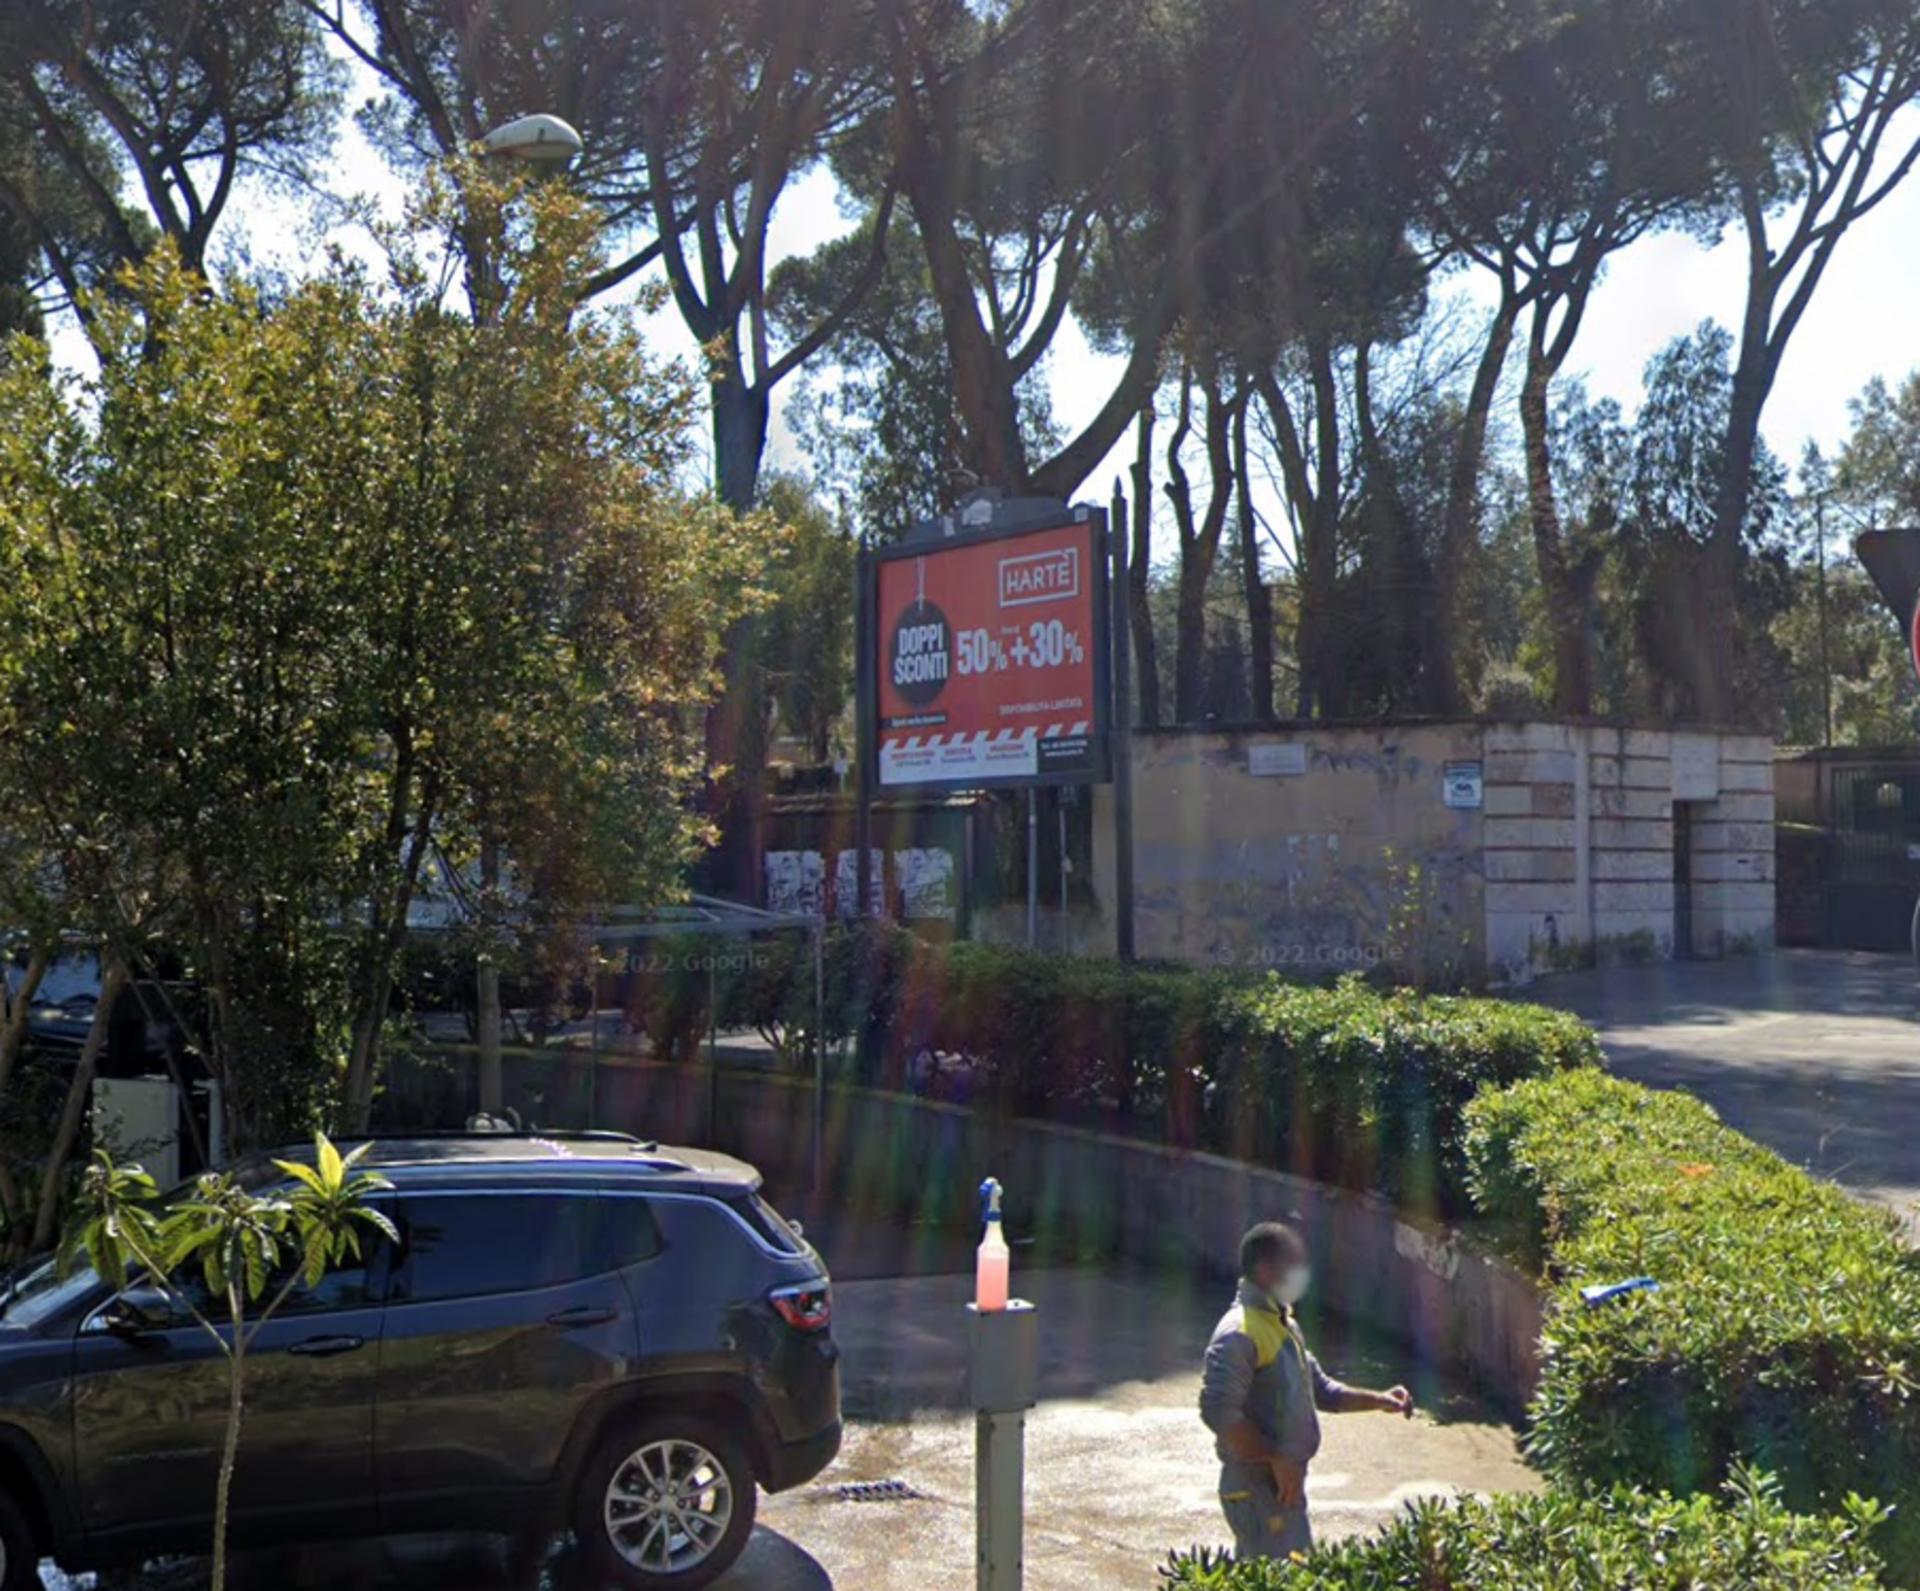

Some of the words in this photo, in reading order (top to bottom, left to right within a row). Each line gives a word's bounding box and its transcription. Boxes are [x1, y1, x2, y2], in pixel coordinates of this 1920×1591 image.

[898, 624, 943, 654] DOPPI
[956, 628, 1008, 676] 50%
[894, 652, 948, 685] SCONTI
